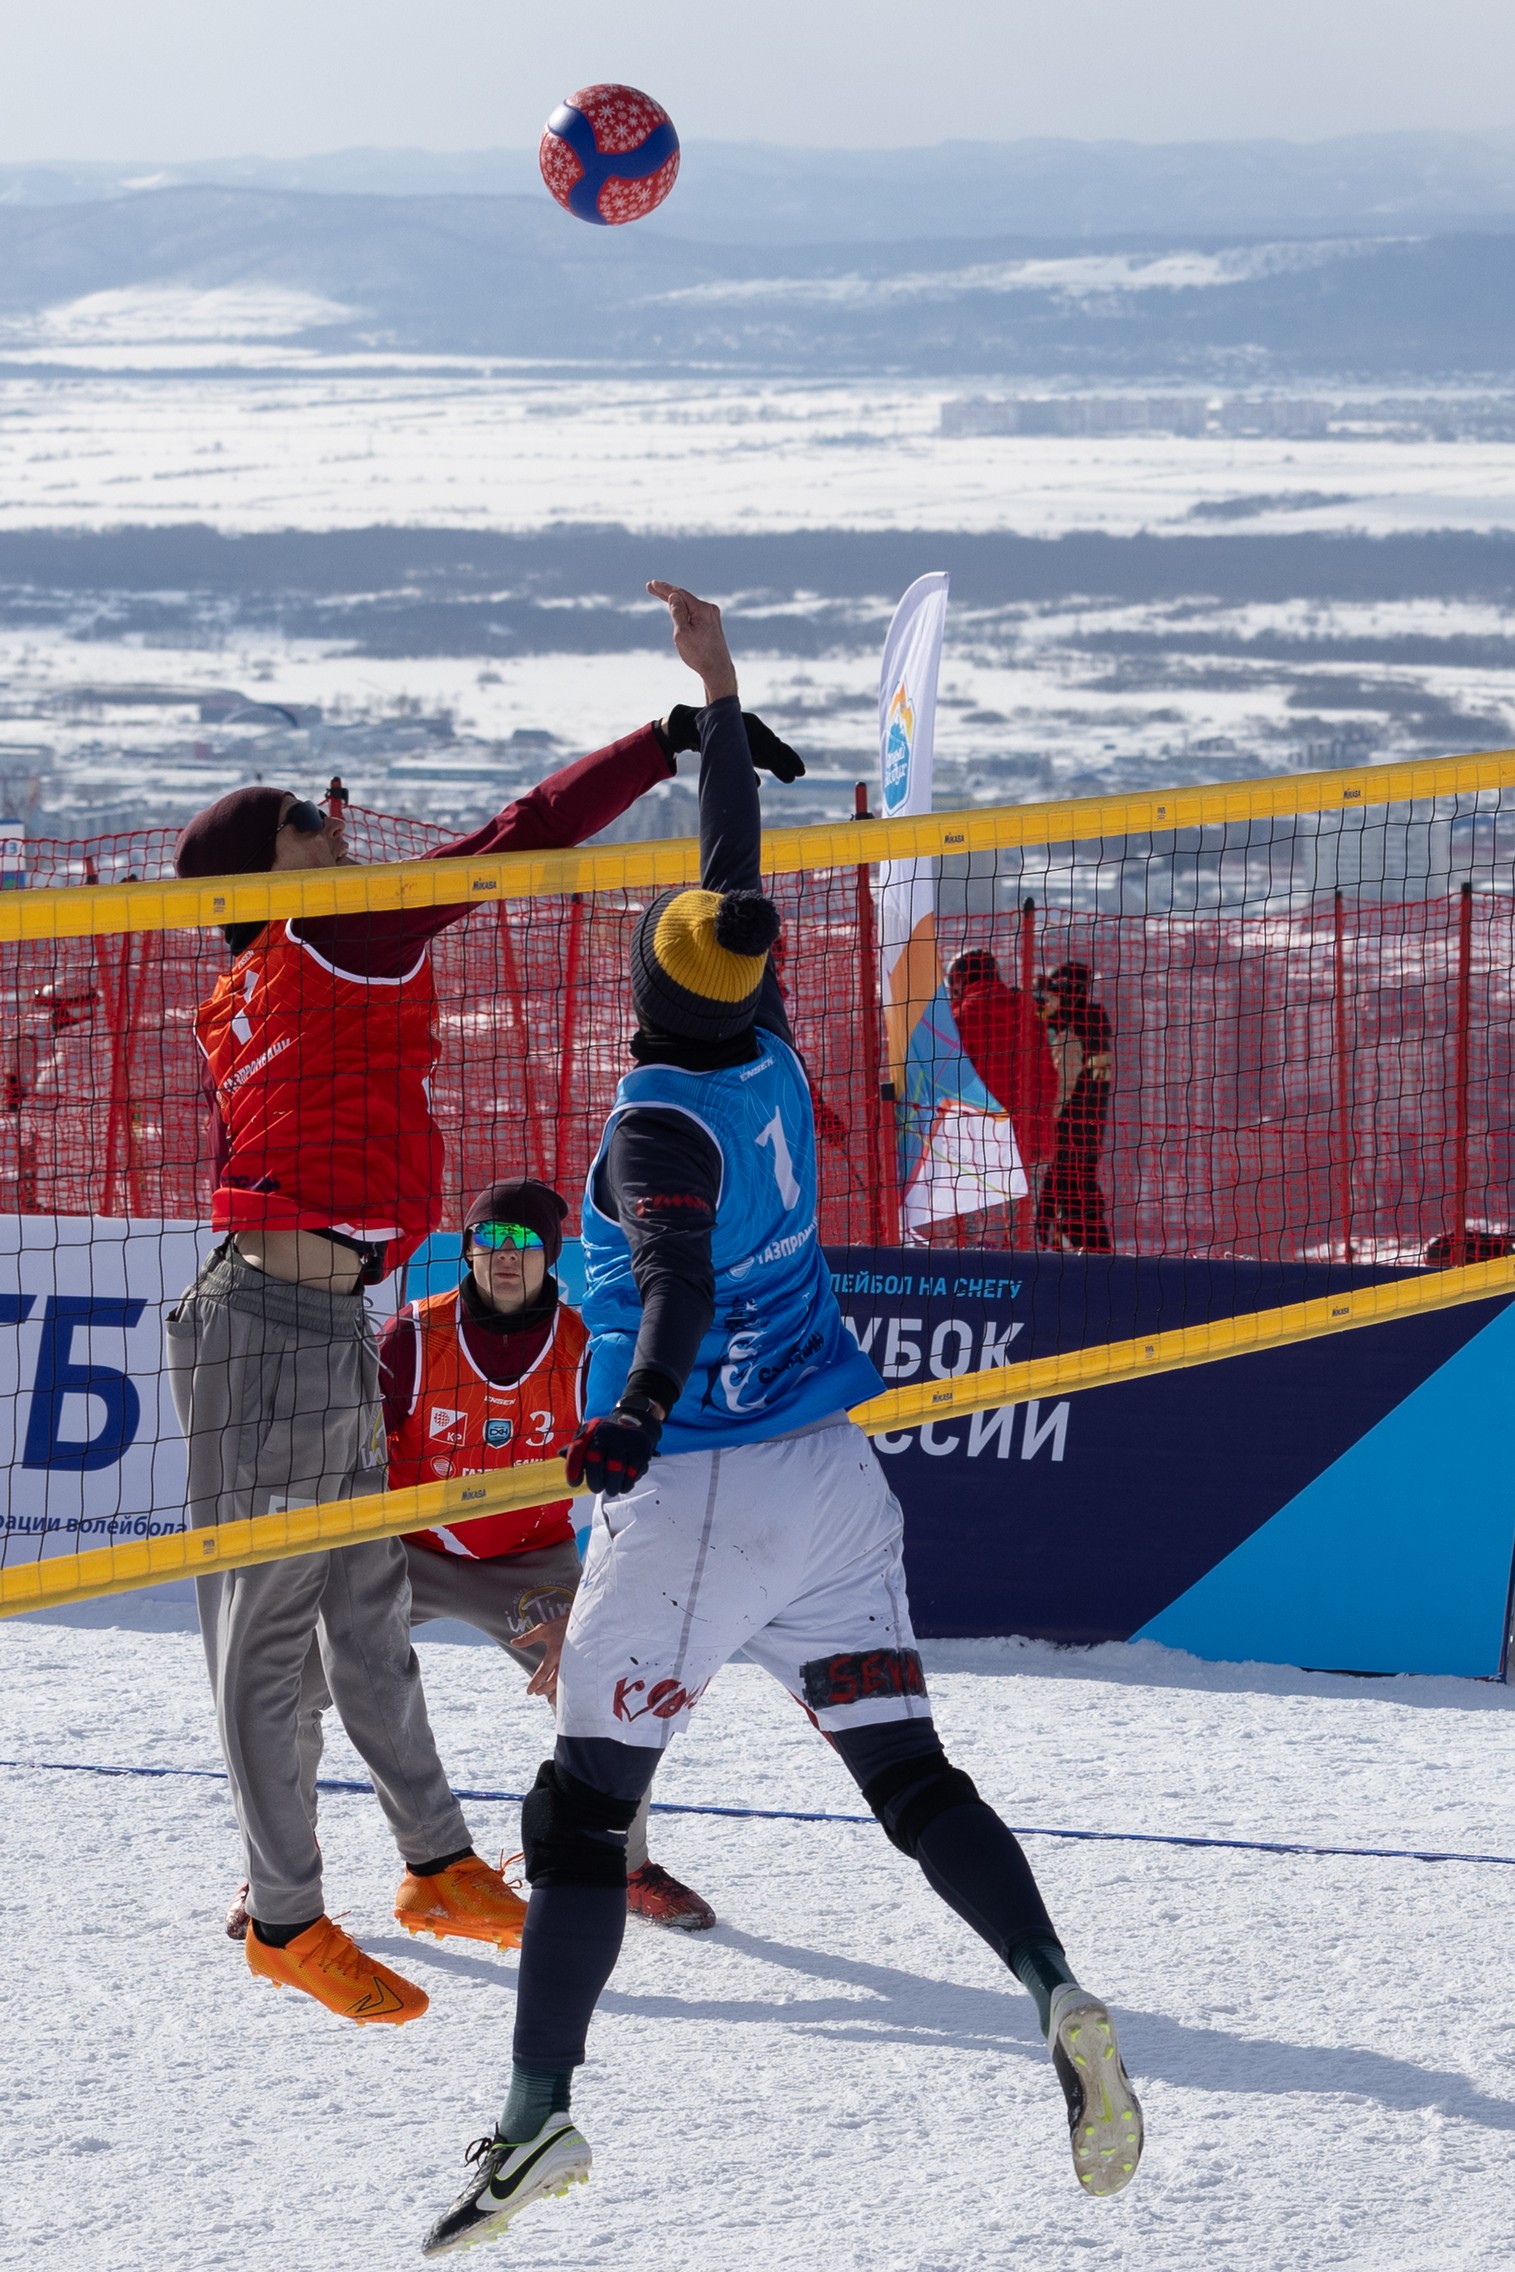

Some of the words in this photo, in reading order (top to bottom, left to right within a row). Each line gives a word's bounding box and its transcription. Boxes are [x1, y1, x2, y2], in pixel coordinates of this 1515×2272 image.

[754, 1105, 800, 1211] 1
[918, 1276, 947, 1297] НА
[954, 1277, 1023, 1299] СНЕГУ
[525, 1410, 556, 1447] 3
[66, 1515, 187, 1537] волейбола
